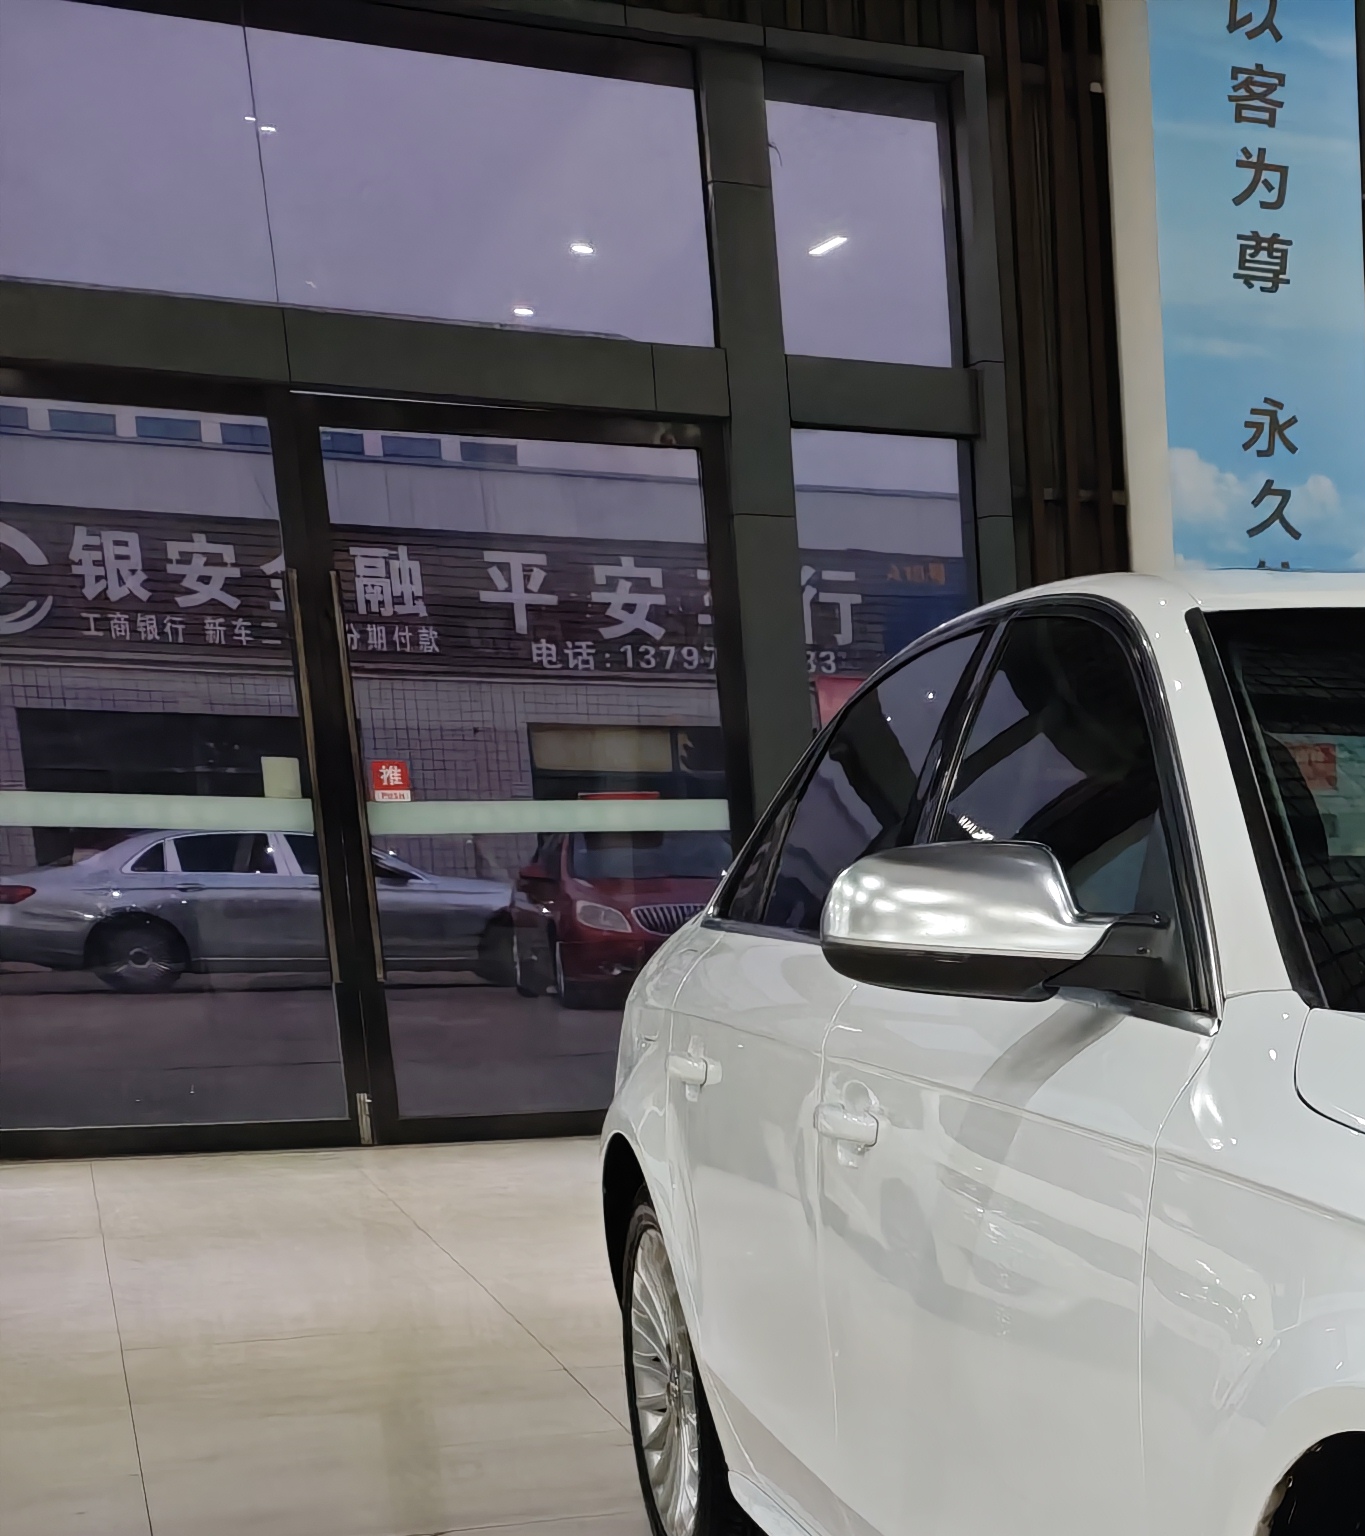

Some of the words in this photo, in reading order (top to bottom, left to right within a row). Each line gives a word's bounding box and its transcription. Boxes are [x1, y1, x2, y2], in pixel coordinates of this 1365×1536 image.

[1242, 397, 1302, 569] 永久
[80, 612, 187, 644] 工商银行
